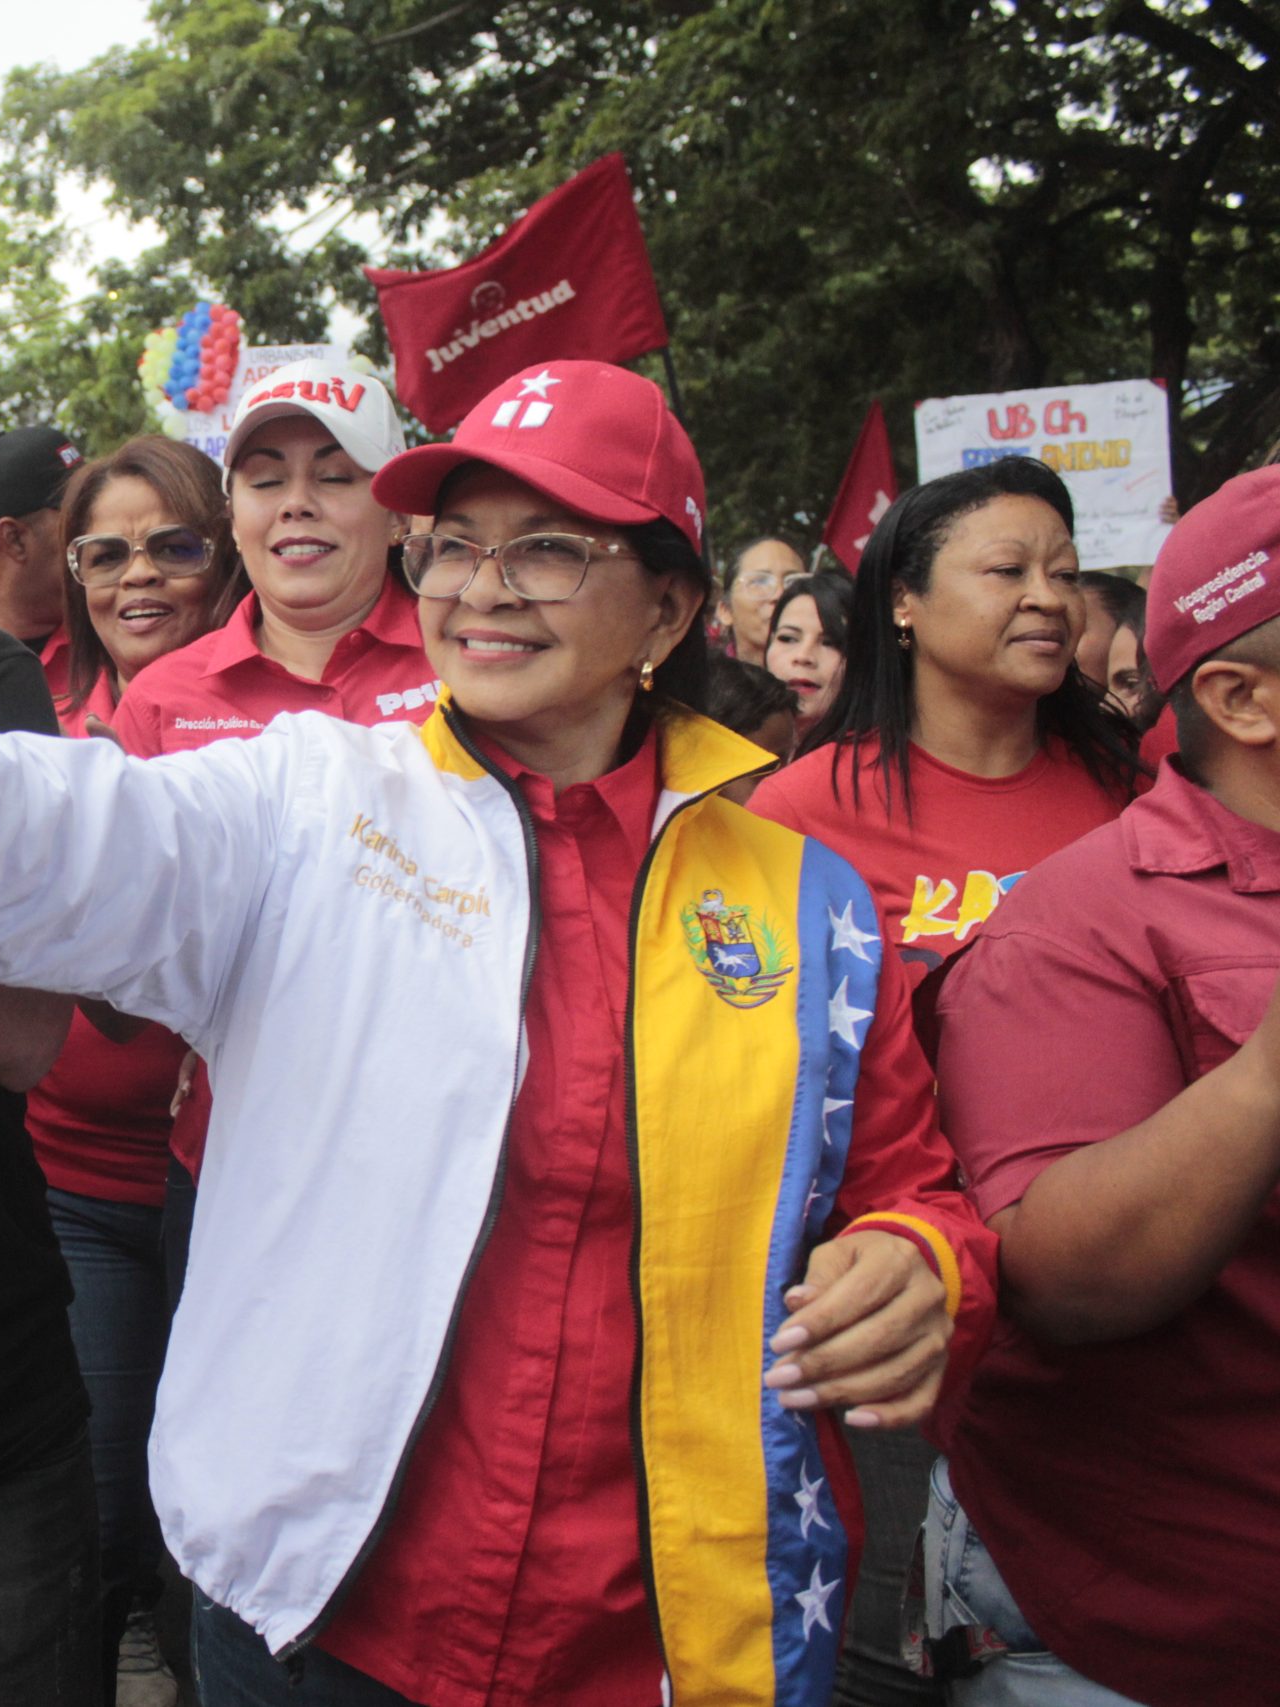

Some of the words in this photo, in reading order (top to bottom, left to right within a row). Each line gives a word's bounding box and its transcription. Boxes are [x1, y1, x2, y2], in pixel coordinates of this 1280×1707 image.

[1173, 551, 1269, 613] Vicepresidencia
[1225, 571, 1266, 603] Central
[175, 716, 216, 730] Dirección
[217, 716, 248, 730] Política
[350, 813, 418, 877] Karina
[354, 864, 473, 948] Gobernadora
